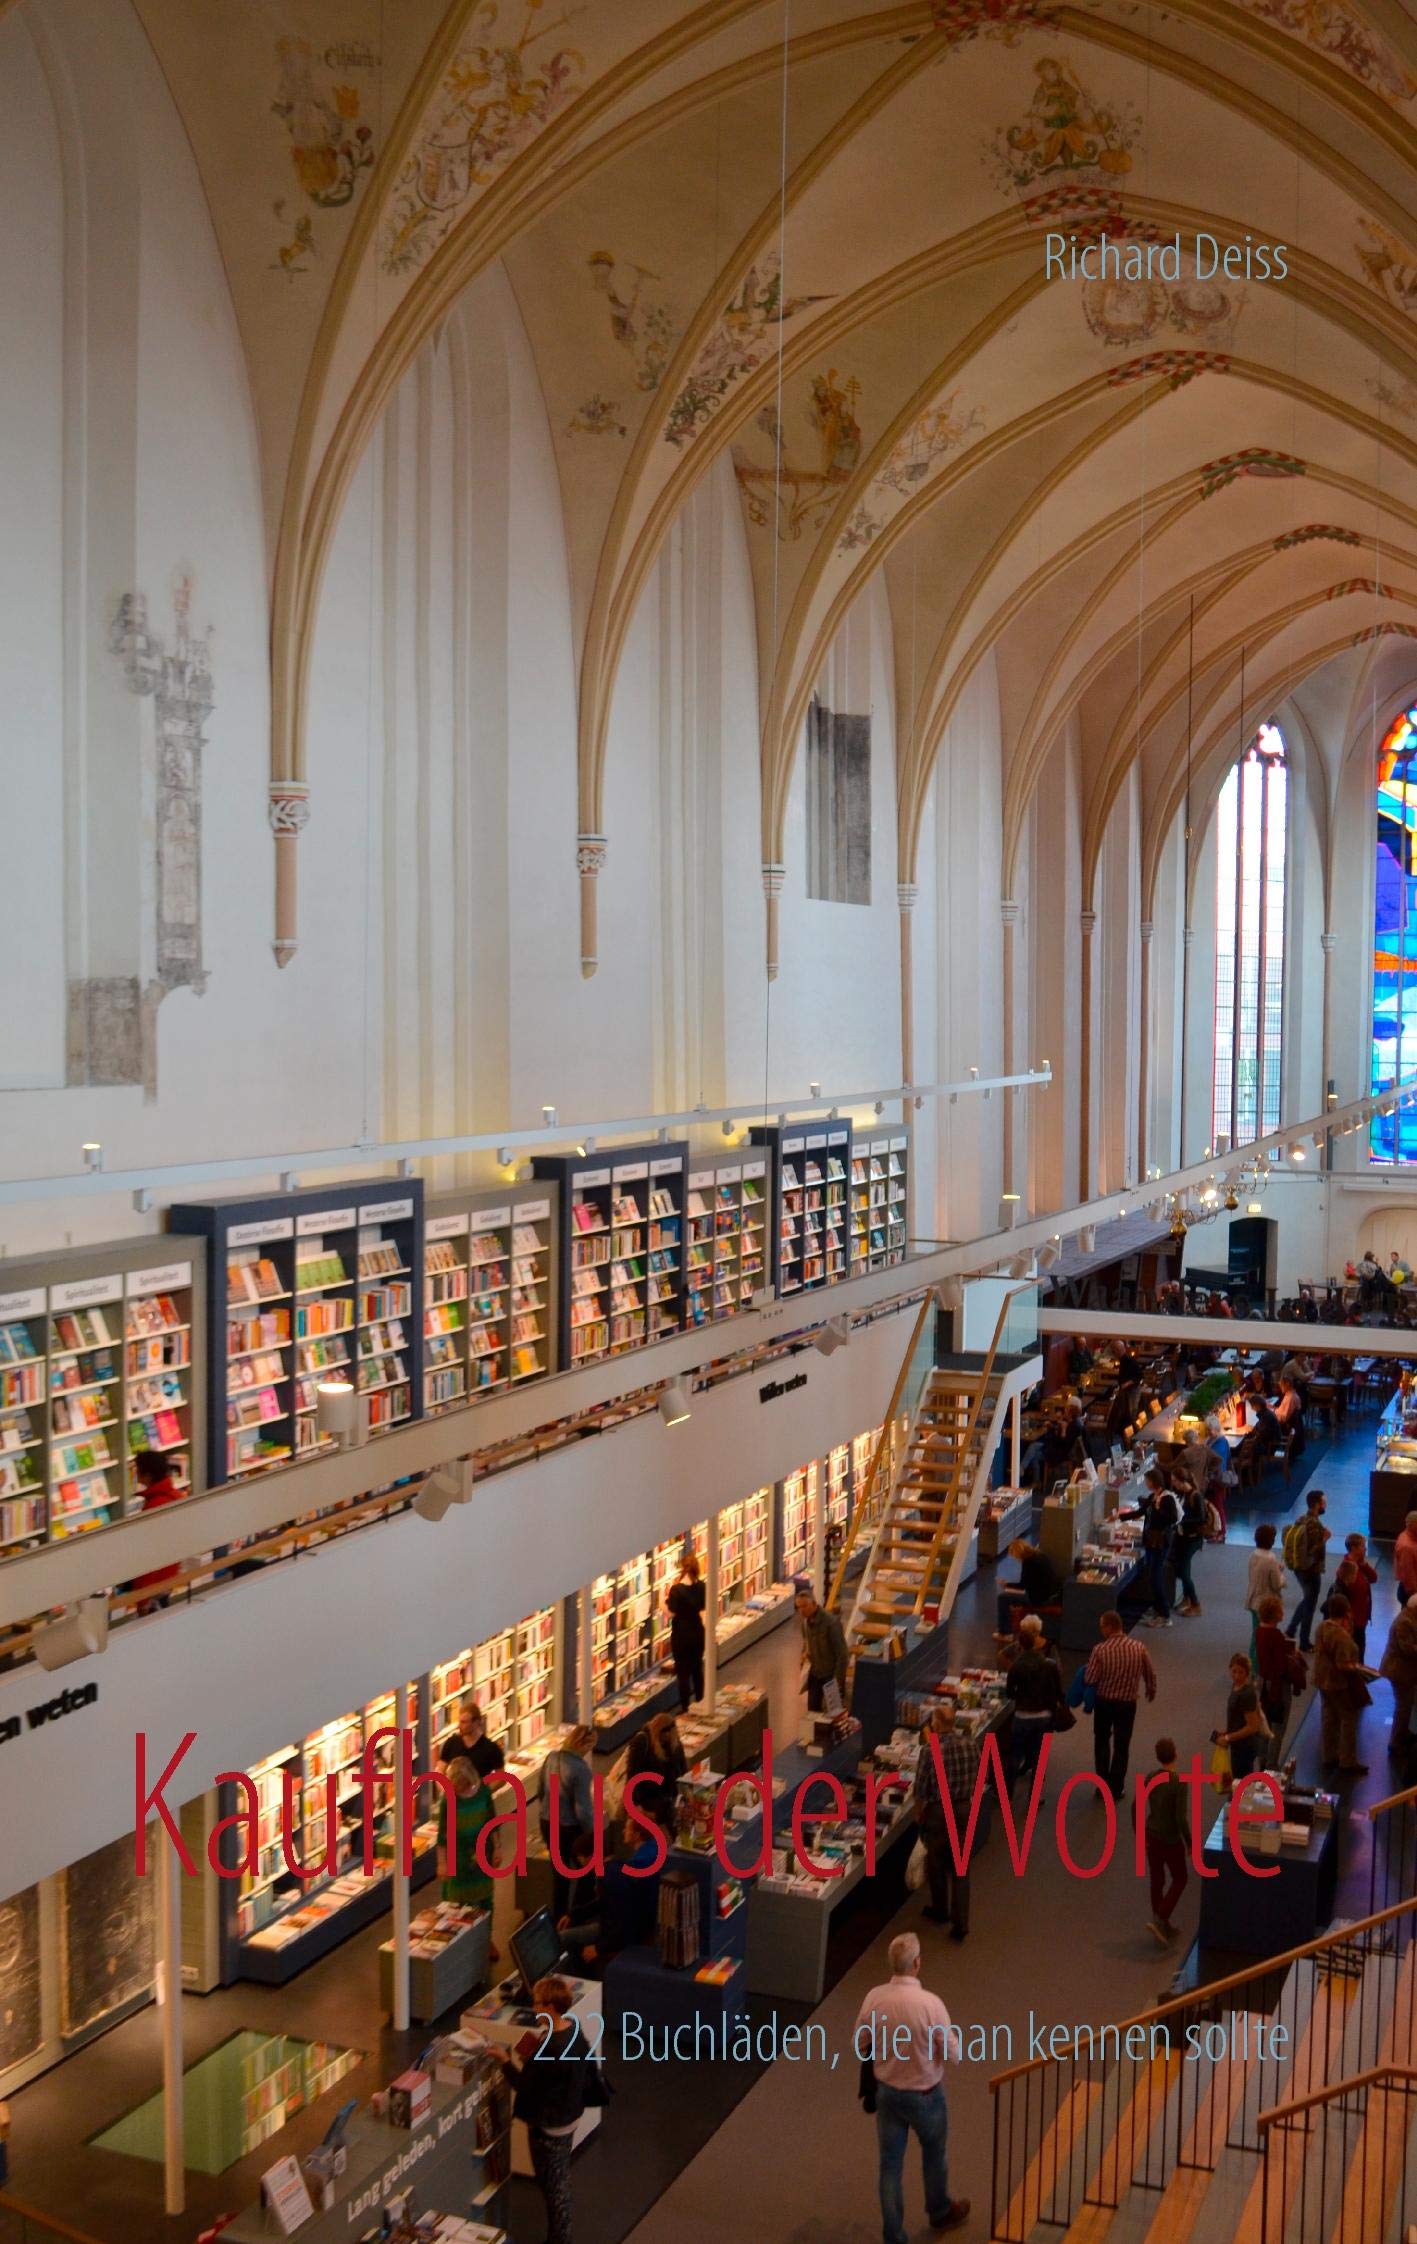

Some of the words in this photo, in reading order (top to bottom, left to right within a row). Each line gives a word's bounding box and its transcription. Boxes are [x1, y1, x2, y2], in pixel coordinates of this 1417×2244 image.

[26, 1683, 98, 1729] weten
[348, 2181, 381, 2223] Lang
[383, 2134, 436, 2196] geleden,
[438, 2102, 463, 2138] kort
